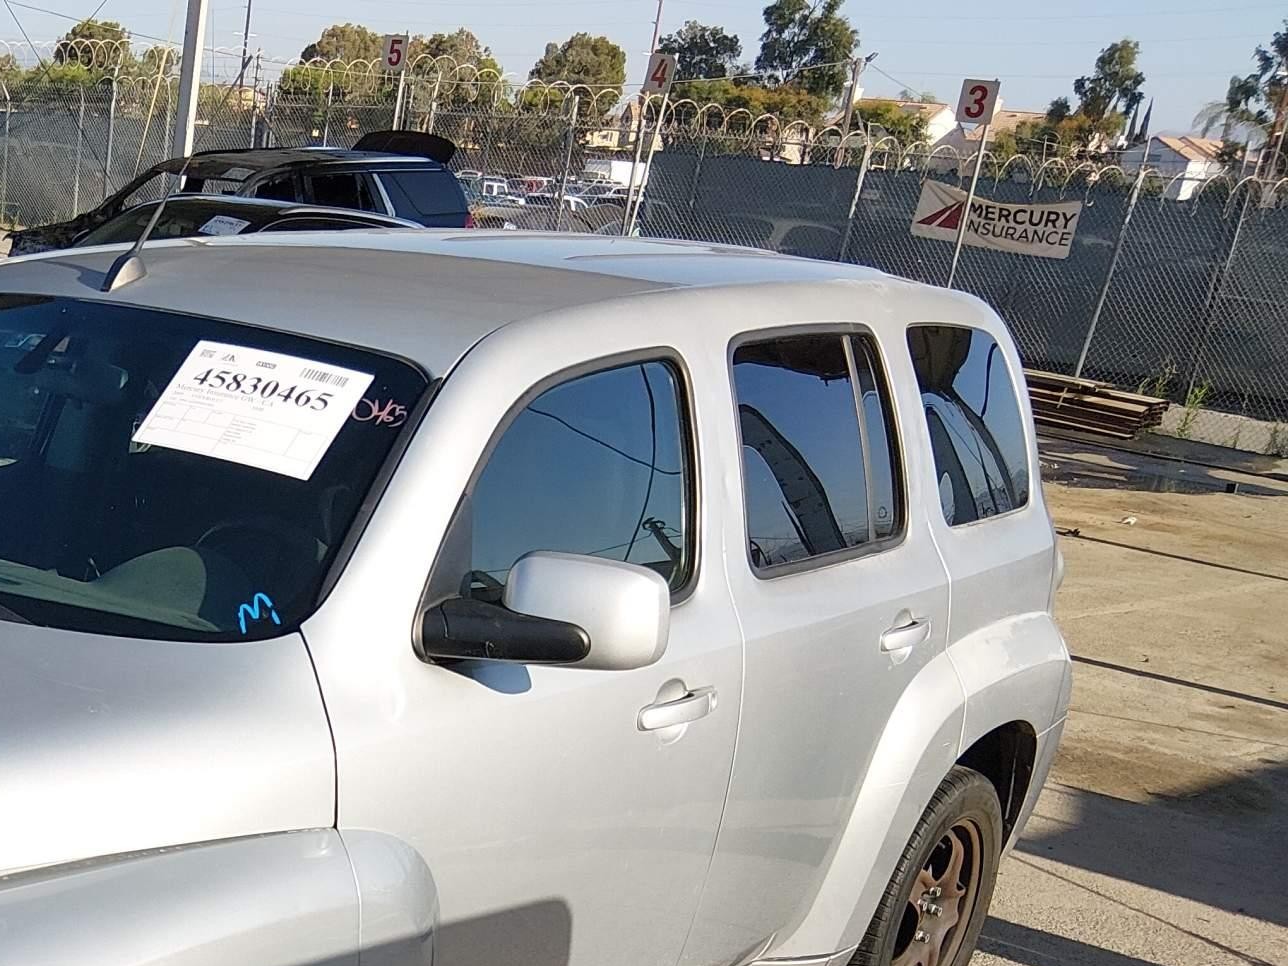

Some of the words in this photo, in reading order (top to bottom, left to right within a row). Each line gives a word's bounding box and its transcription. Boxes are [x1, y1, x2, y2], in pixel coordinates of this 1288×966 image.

[387, 39, 403, 67] 5
[650, 58, 668, 88] 4
[964, 85, 988, 118] 3
[968, 202, 1076, 230] MERCURY
[966, 219, 1073, 246] NSURANCE
[193, 367, 335, 411] 45830465
[238, 592, 281, 634] M
